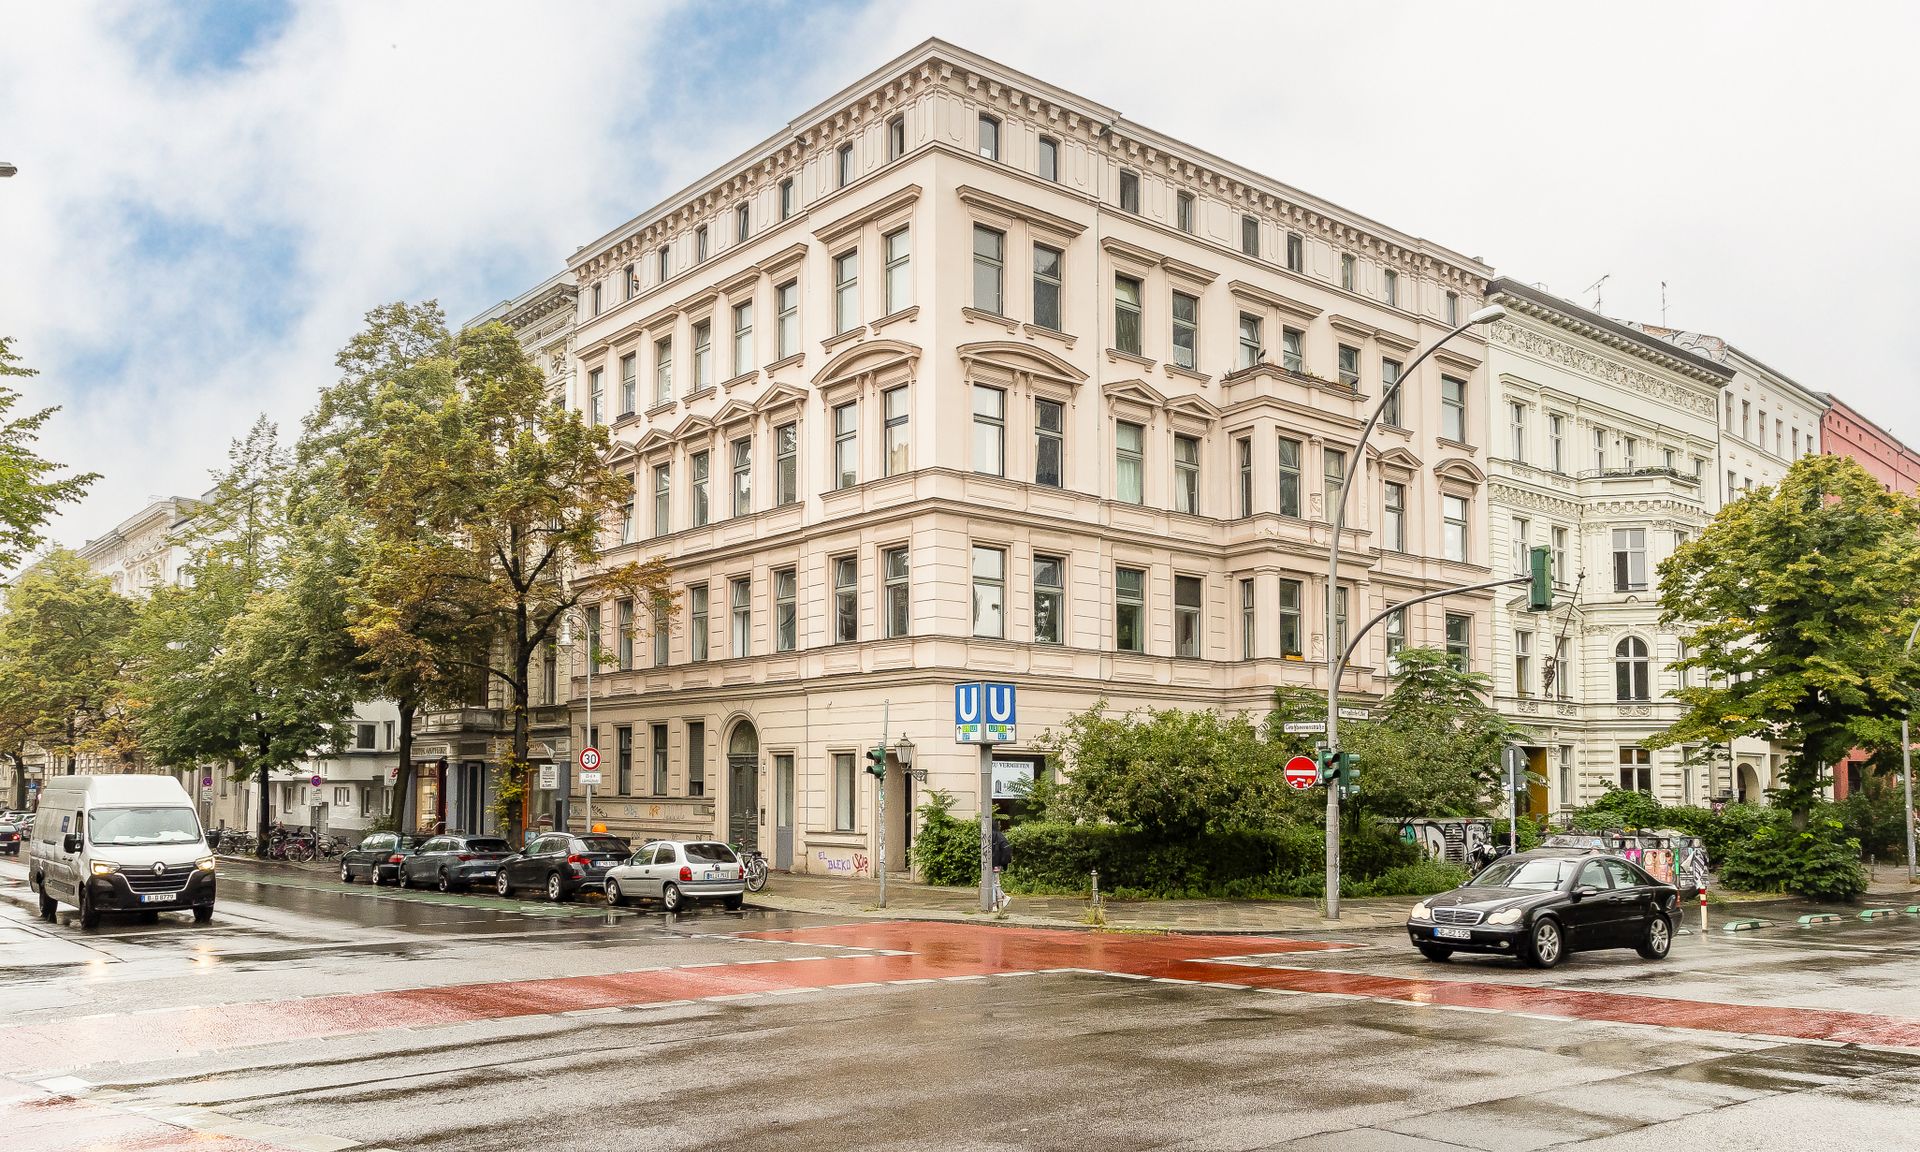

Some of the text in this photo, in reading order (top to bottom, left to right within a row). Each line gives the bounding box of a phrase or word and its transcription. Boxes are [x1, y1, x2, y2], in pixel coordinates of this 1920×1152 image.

[960, 687, 978, 722] U
[990, 687, 1011, 722] U
[584, 753, 597, 764] 30
